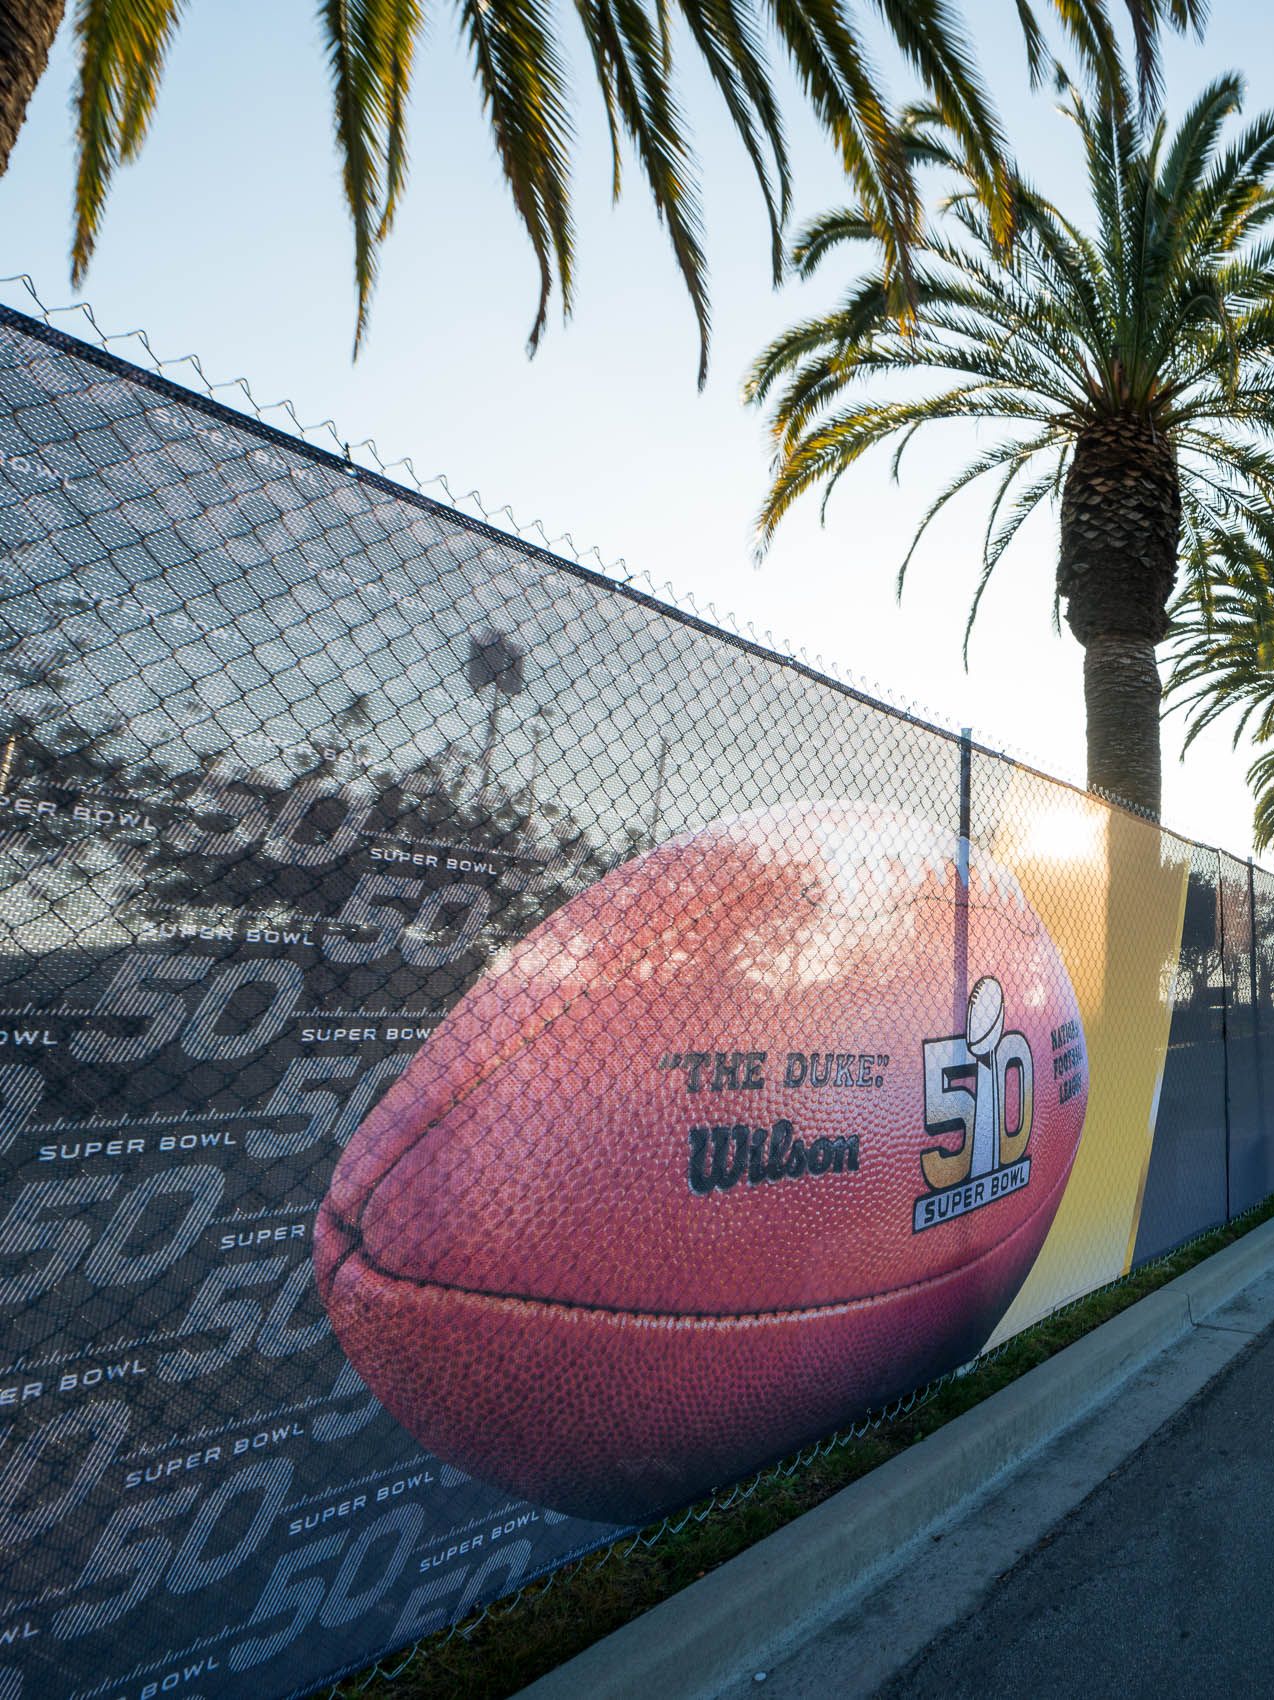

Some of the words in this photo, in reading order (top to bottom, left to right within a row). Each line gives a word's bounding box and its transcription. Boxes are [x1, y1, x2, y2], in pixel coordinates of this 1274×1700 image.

[72, 806, 160, 831] BOWL
[369, 847, 438, 868] SUPER
[446, 858, 497, 875] BOWL
[247, 929, 315, 946] BOWL
[321, 872, 491, 967] 50
[68, 953, 304, 1064] 50
[301, 1028, 376, 1041] SUPER
[920, 1030, 1034, 1190] 50
[38, 1138, 145, 1161] SUPER
[159, 1131, 237, 1150] BOWL
[687, 1119, 860, 1195] Wilson
[924, 1181, 984, 1225] SUPER
[990, 1167, 1025, 1199] BOWL
[220, 1225, 305, 1250] SUPER
[59, 1360, 146, 1391] BOWL
[126, 1449, 220, 1488] SUPER
[233, 1422, 304, 1456] BOWL
[288, 1495, 367, 1535] SUPER
[377, 1471, 434, 1501] BOWL
[52, 1457, 296, 1640] 50
[419, 1534, 484, 1573] SUPER
[491, 1511, 540, 1539] BOWL
[229, 1503, 424, 1672] 50
[141, 1656, 219, 1700] BOWL
